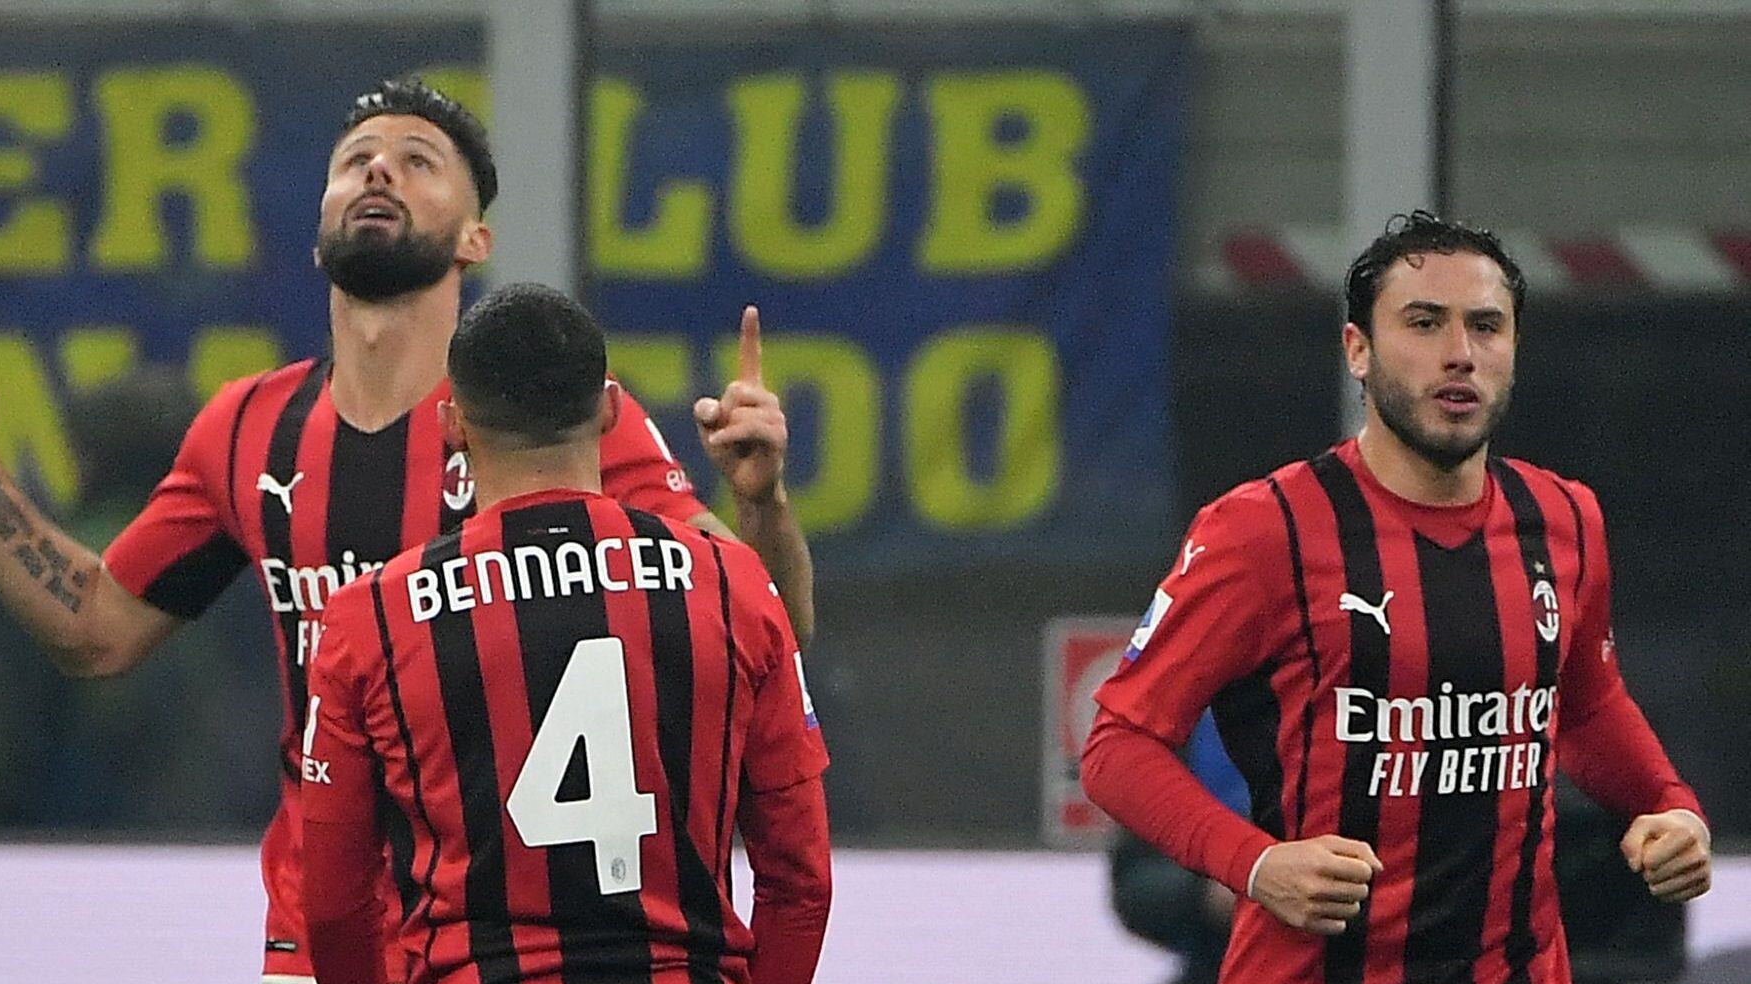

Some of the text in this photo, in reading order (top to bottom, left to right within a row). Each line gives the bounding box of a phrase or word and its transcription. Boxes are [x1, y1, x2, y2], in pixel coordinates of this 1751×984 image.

[428, 68, 1093, 280] LUB
[406, 538, 693, 622] BENNACER
[506, 636, 657, 895] 4
[1368, 741, 1541, 797] FLY BETTER
